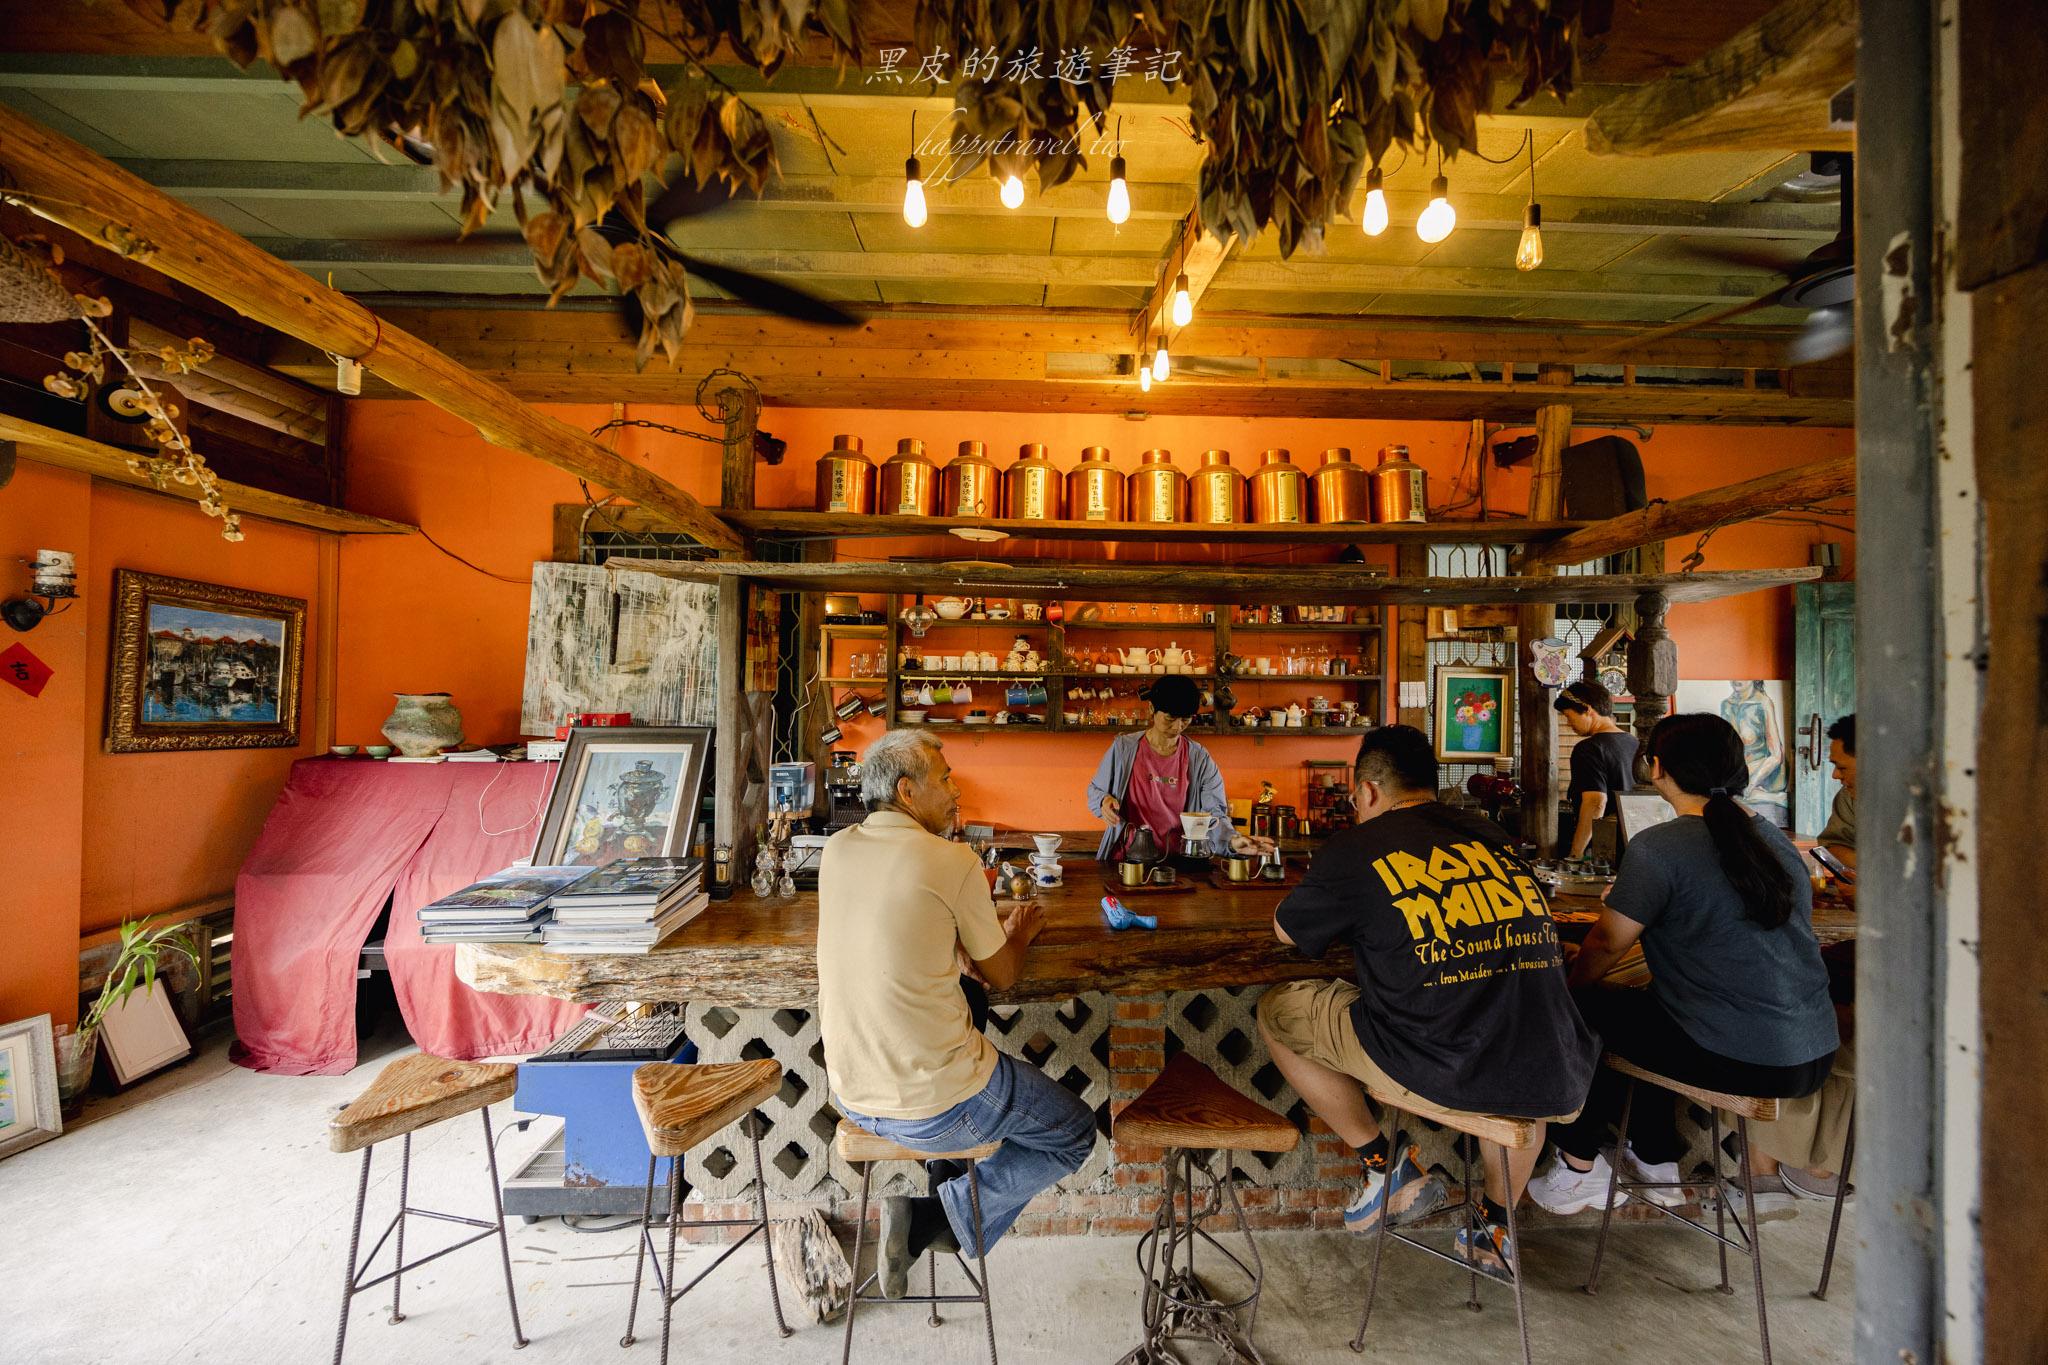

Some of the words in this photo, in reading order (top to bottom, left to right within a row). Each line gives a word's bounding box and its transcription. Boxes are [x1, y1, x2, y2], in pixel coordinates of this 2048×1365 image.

[1372, 841, 1510, 896] IRON
[1414, 939, 1447, 964] The
[1440, 971, 1458, 985] Iron
[1458, 963, 1493, 982] Maiden
[1518, 957, 1549, 969] Invasion
